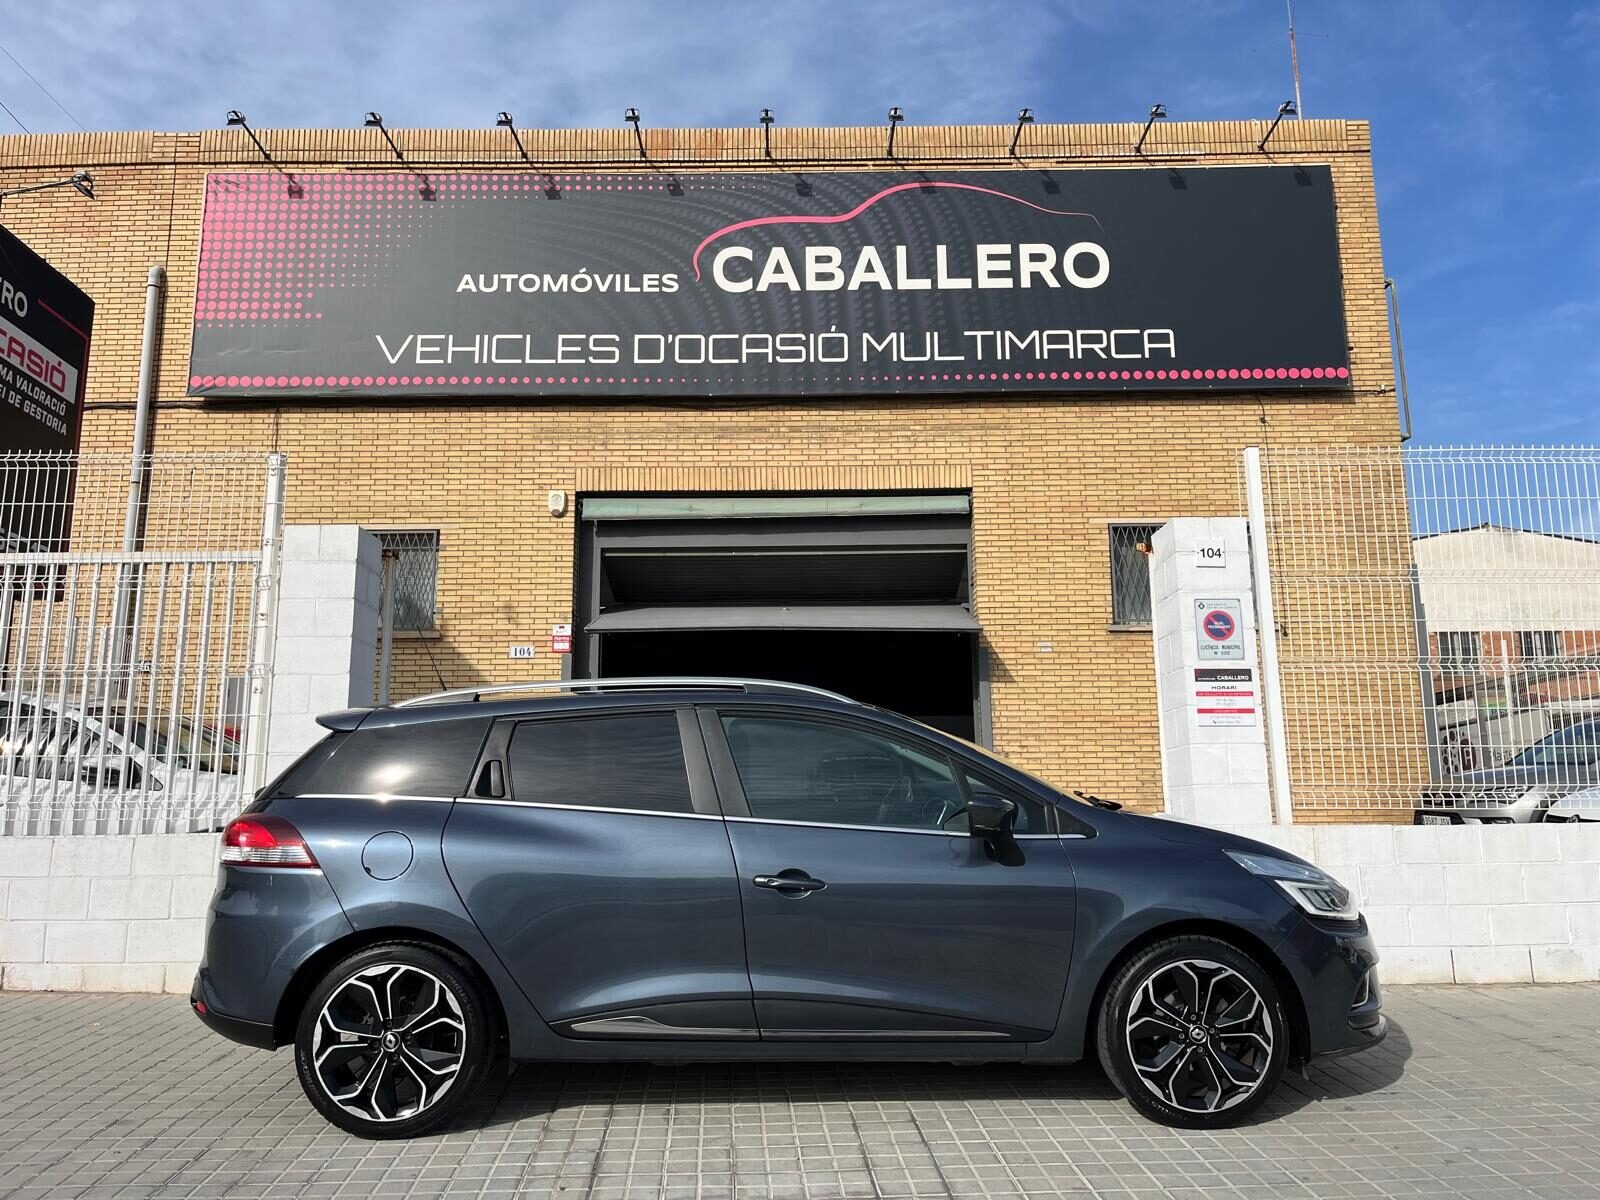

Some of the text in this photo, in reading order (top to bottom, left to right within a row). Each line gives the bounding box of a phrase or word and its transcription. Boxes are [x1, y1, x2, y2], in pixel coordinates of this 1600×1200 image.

[456, 242, 1110, 293] AUTOMÓVILES CABALLERO
[375, 334, 620, 365] VEHICLES
[633, 326, 848, 364] D'OCASIÓ
[8, 390, 22, 408] DE
[23, 400, 67, 436] GESTORIA
[16, 375, 66, 416] VALORACIÓ
[1200, 548, 1222, 559] 104
[514, 647, 531, 657] 104
